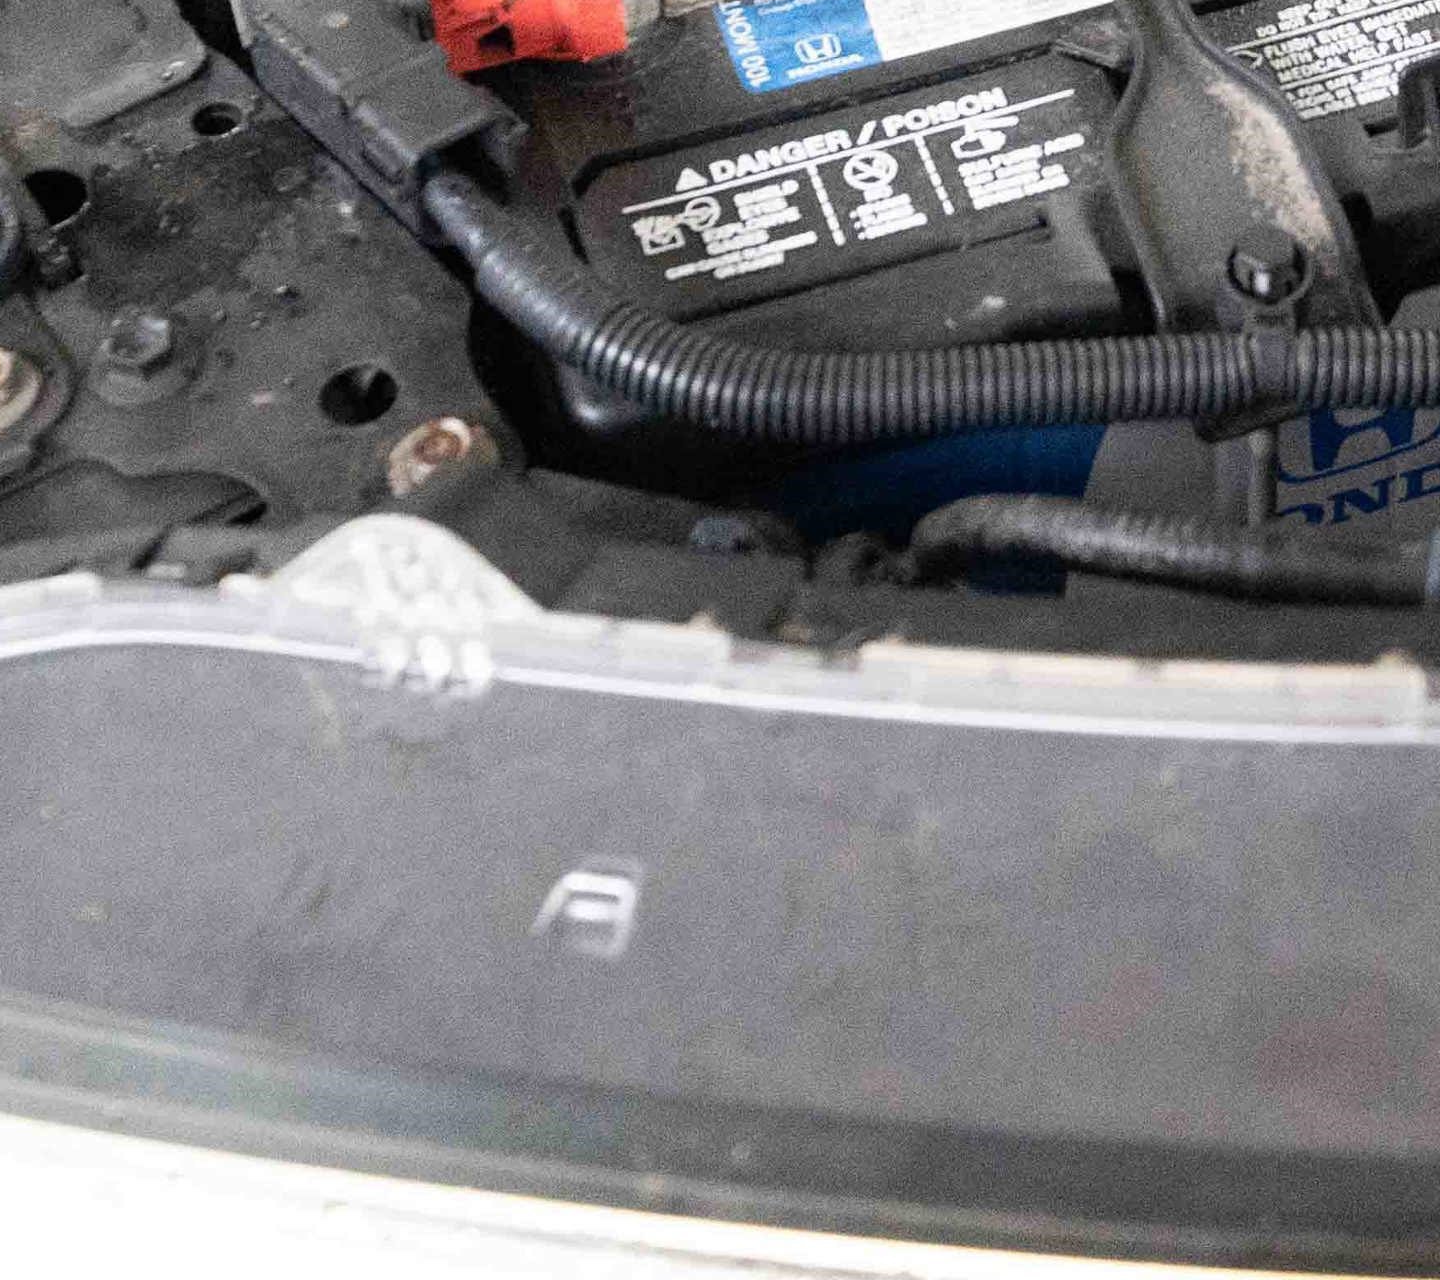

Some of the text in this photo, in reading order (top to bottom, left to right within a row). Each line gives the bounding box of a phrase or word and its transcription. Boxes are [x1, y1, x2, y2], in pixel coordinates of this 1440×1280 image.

[740, 52, 773, 89] 100
[708, 128, 853, 182] DANGER
[881, 86, 1008, 138] POISON
